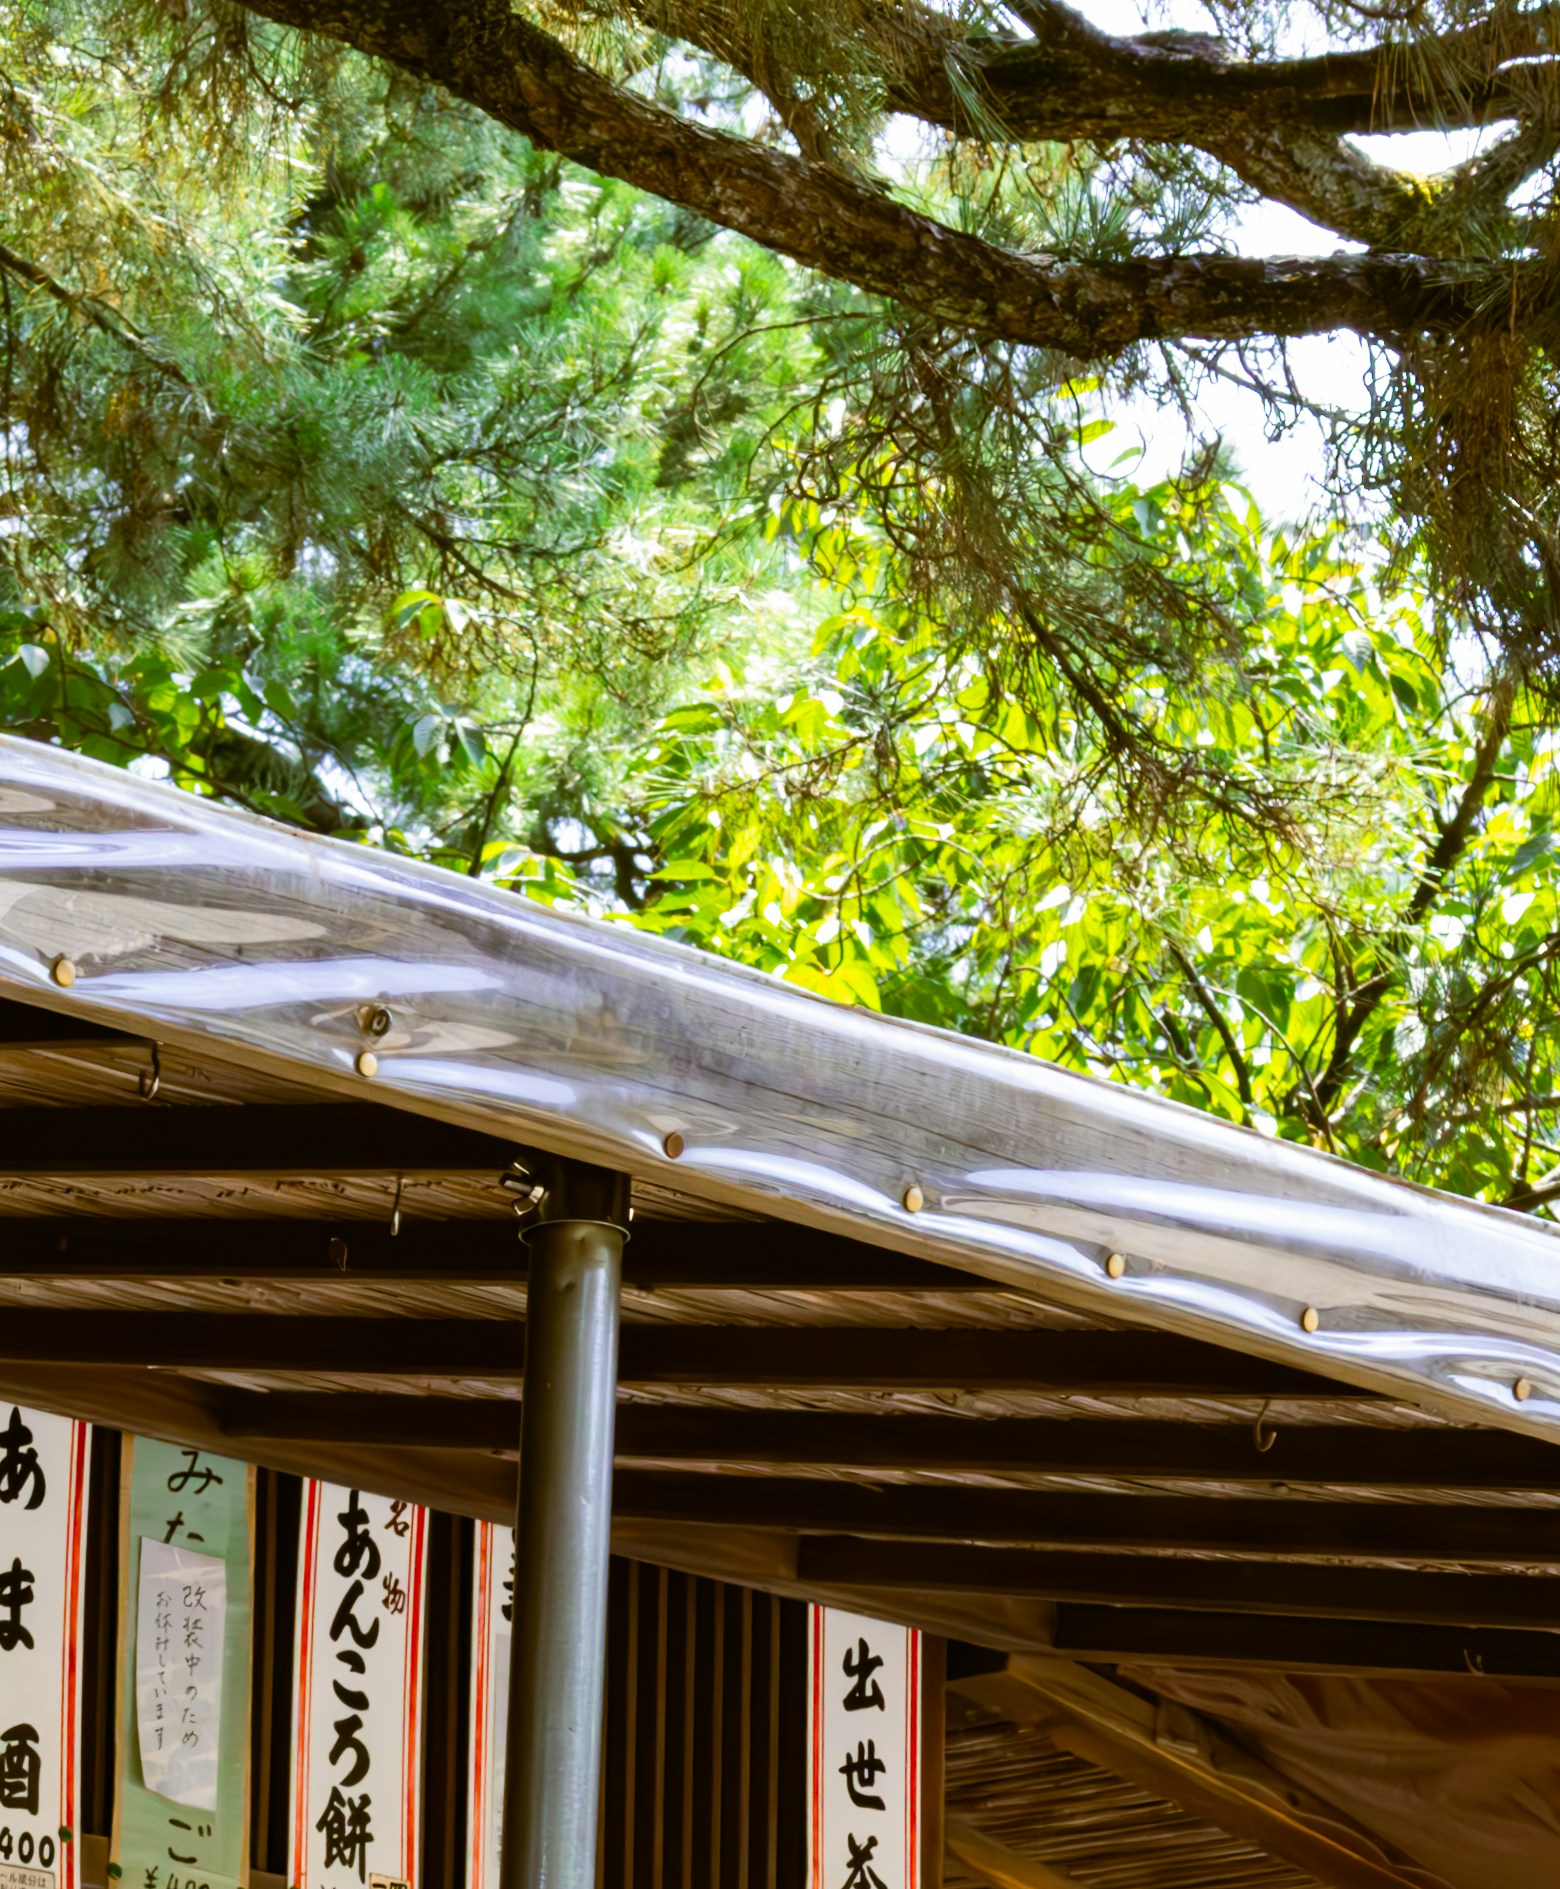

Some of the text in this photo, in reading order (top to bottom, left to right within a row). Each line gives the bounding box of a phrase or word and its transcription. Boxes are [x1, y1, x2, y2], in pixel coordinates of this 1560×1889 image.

[154, 1590, 173, 1752] お休みしています
[181, 1585, 208, 1748] 改装中のため
[316, 1488, 382, 1884] あんころ餅
